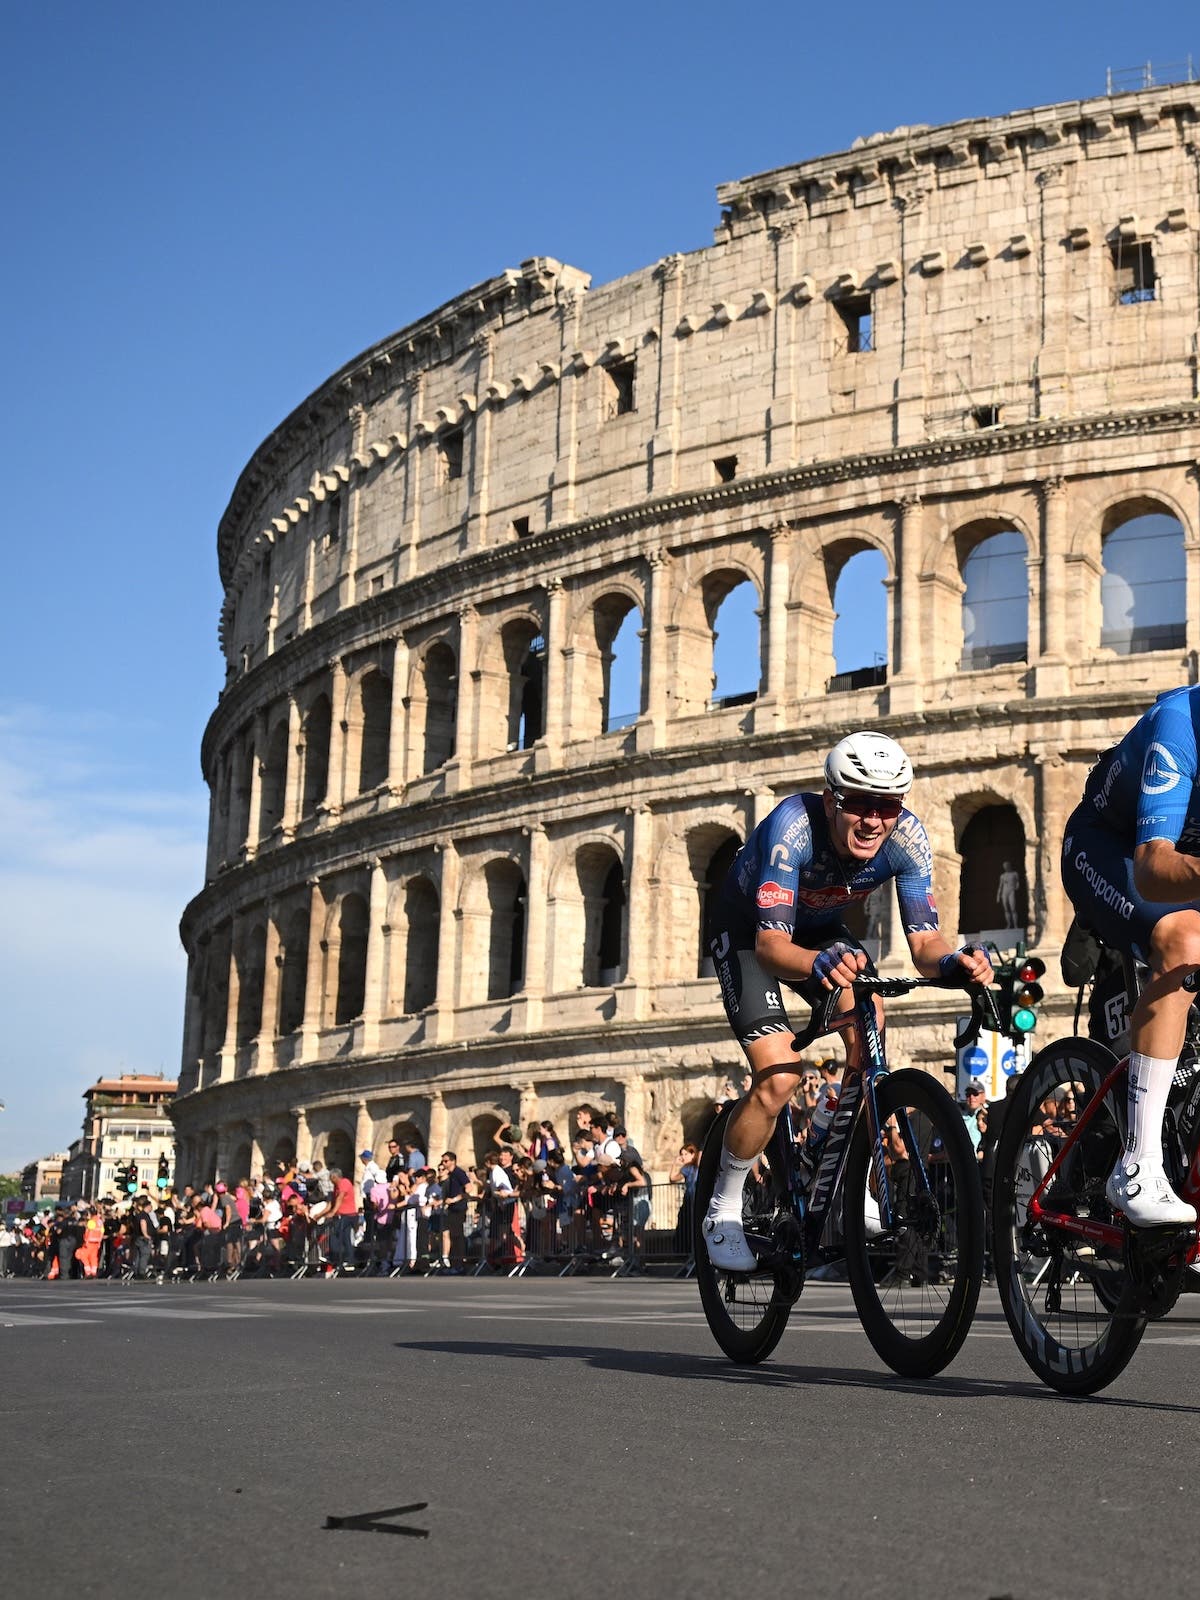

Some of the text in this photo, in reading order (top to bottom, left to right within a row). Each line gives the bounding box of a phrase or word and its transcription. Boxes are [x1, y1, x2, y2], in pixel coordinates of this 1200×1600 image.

[757, 888, 789, 902] lpecin
[1075, 851, 1135, 920] Groupama
[720, 960, 740, 1016] PREMIER
[1108, 997, 1126, 1036] 57
[809, 1085, 860, 1212] CANYON
